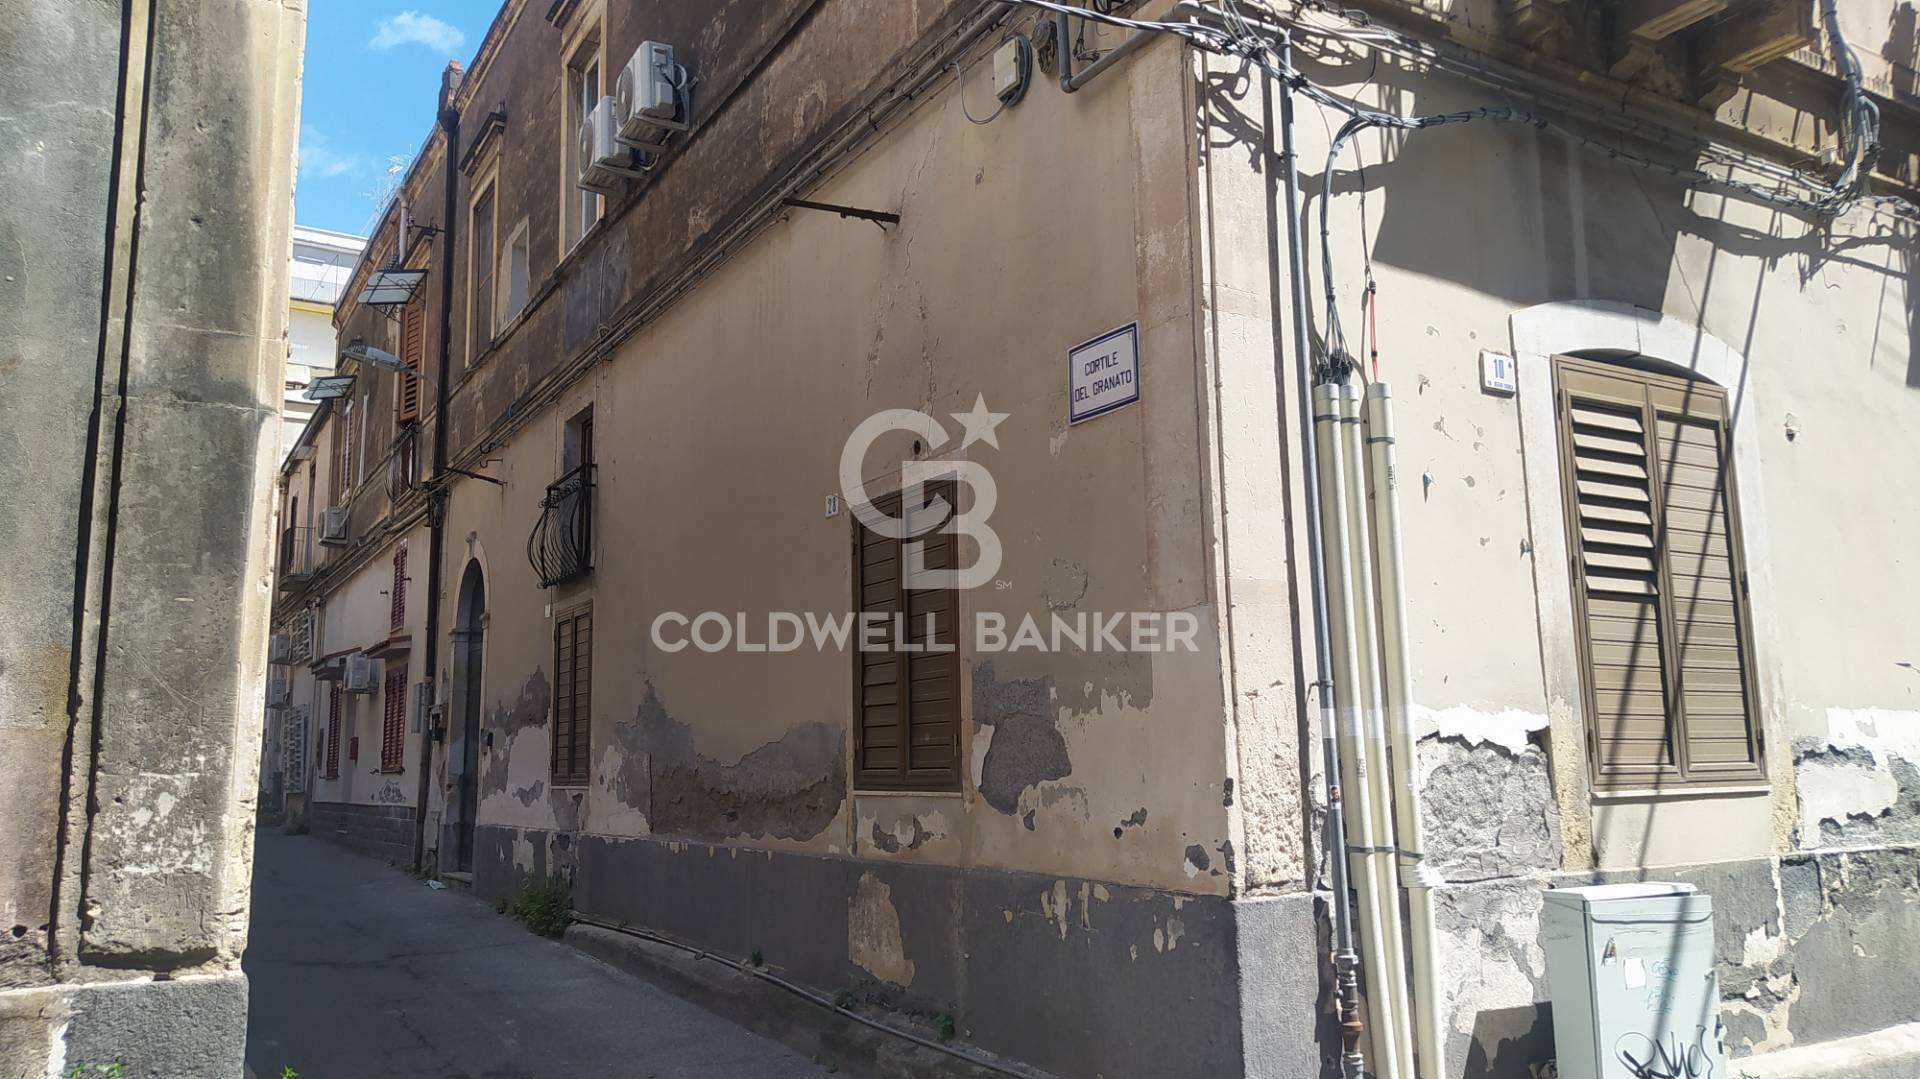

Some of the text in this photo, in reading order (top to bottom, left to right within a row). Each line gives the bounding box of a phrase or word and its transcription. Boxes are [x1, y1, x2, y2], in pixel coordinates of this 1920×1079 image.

[1084, 351, 1119, 376] CORTILE
[1493, 358, 1504, 379] 10
[1074, 369, 1132, 402] DEL GRANATO
